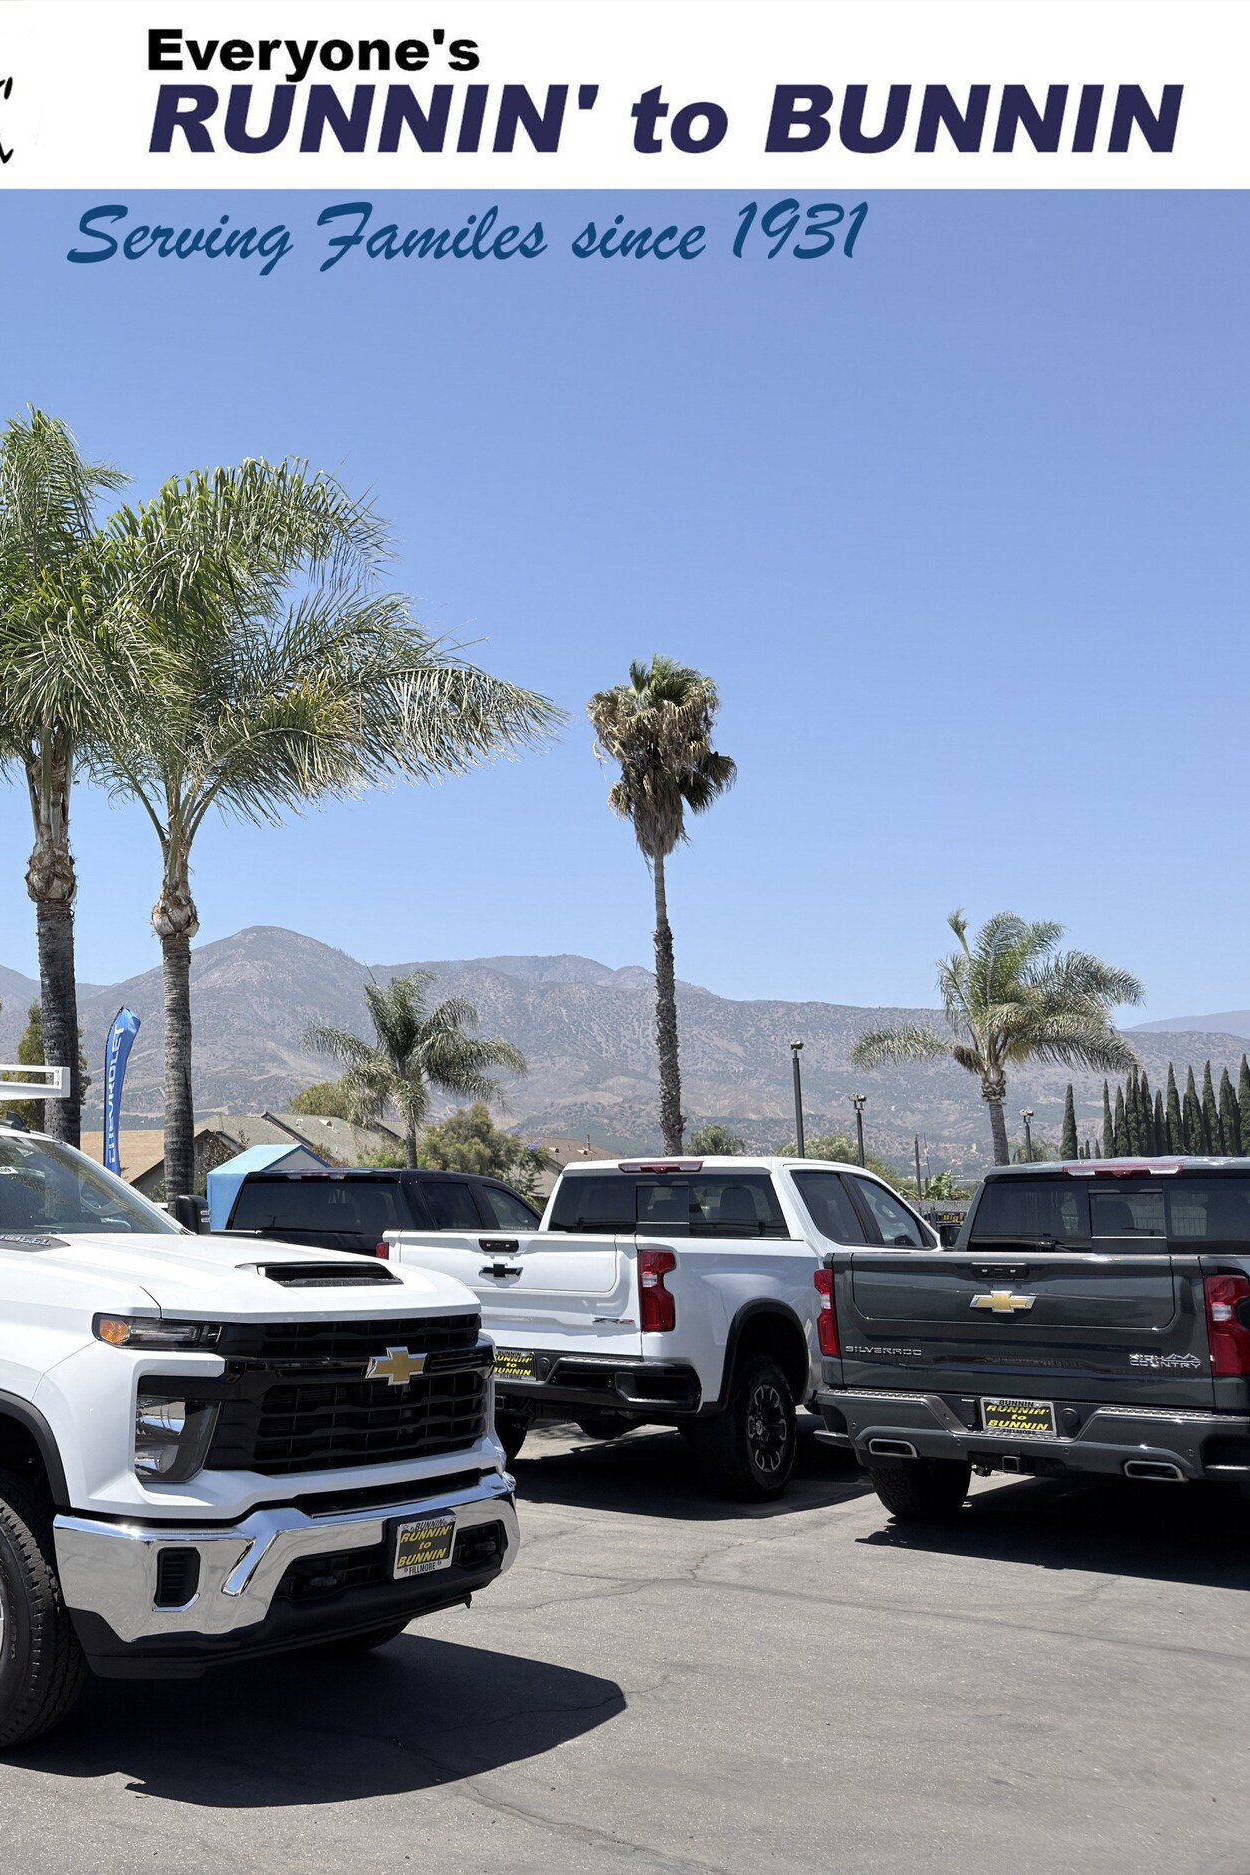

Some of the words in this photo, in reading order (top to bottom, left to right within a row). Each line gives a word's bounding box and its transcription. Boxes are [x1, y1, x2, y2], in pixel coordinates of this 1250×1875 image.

[845, 1345, 922, 1356] SILVERADO
[1130, 1360, 1201, 1369] COUNTRY
[986, 1404, 1050, 1415] RUNNIN'
[988, 1419, 1049, 1430] BUNNIN
[415, 1518, 445, 1531] BUNNIN
[400, 1525, 453, 1543] RUNNIN'
[418, 1541, 432, 1550] to
[397, 1547, 447, 1568] BUNNIN
[409, 1561, 436, 1575] FILLMORE
